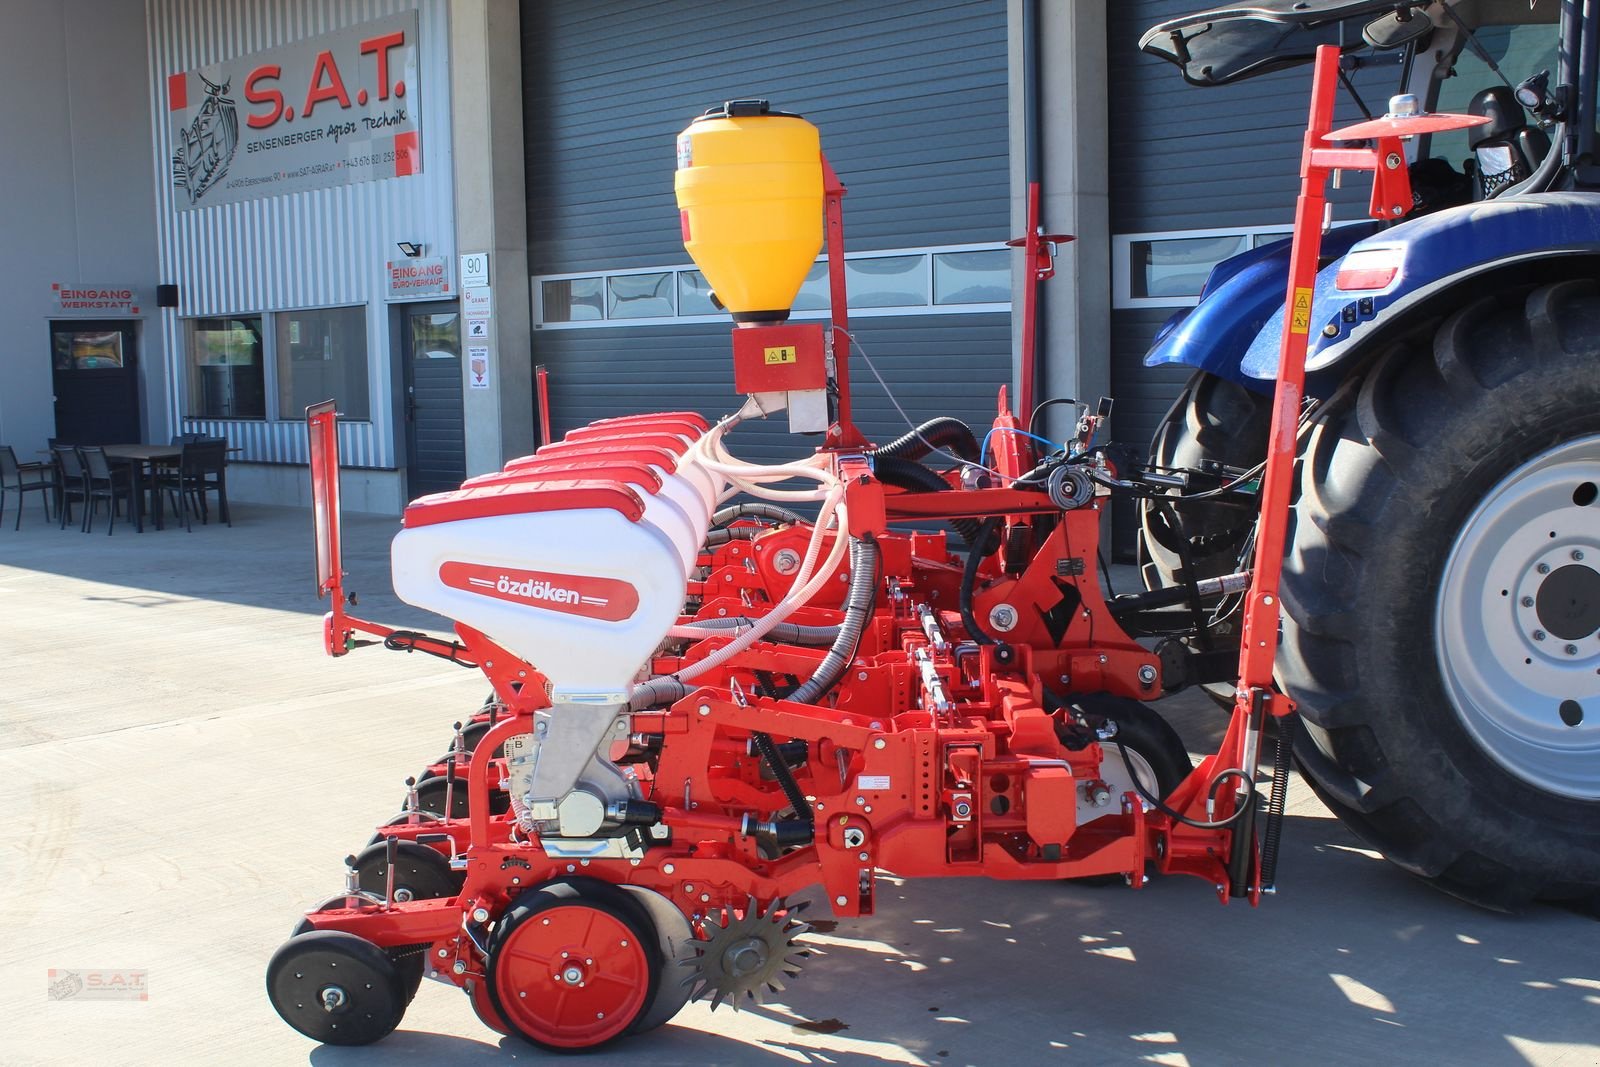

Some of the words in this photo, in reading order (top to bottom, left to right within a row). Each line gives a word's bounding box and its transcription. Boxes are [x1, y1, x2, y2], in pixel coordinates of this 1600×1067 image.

[244, 30, 406, 129] S.A.T.
[247, 129, 323, 154] SENSENBERGER
[326, 122, 357, 144] Agrar
[362, 109, 407, 131] Technik
[359, 155, 370, 167] 676
[372, 154, 381, 165] 821
[383, 151, 395, 163] 252
[392, 264, 443, 279] EINGANG
[467, 257, 481, 274] 90
[61, 289, 132, 299] EINGANG
[61, 301, 132, 309] WERKSTATT
[496, 575, 580, 605] özdöken
[514, 740, 523, 749] B
